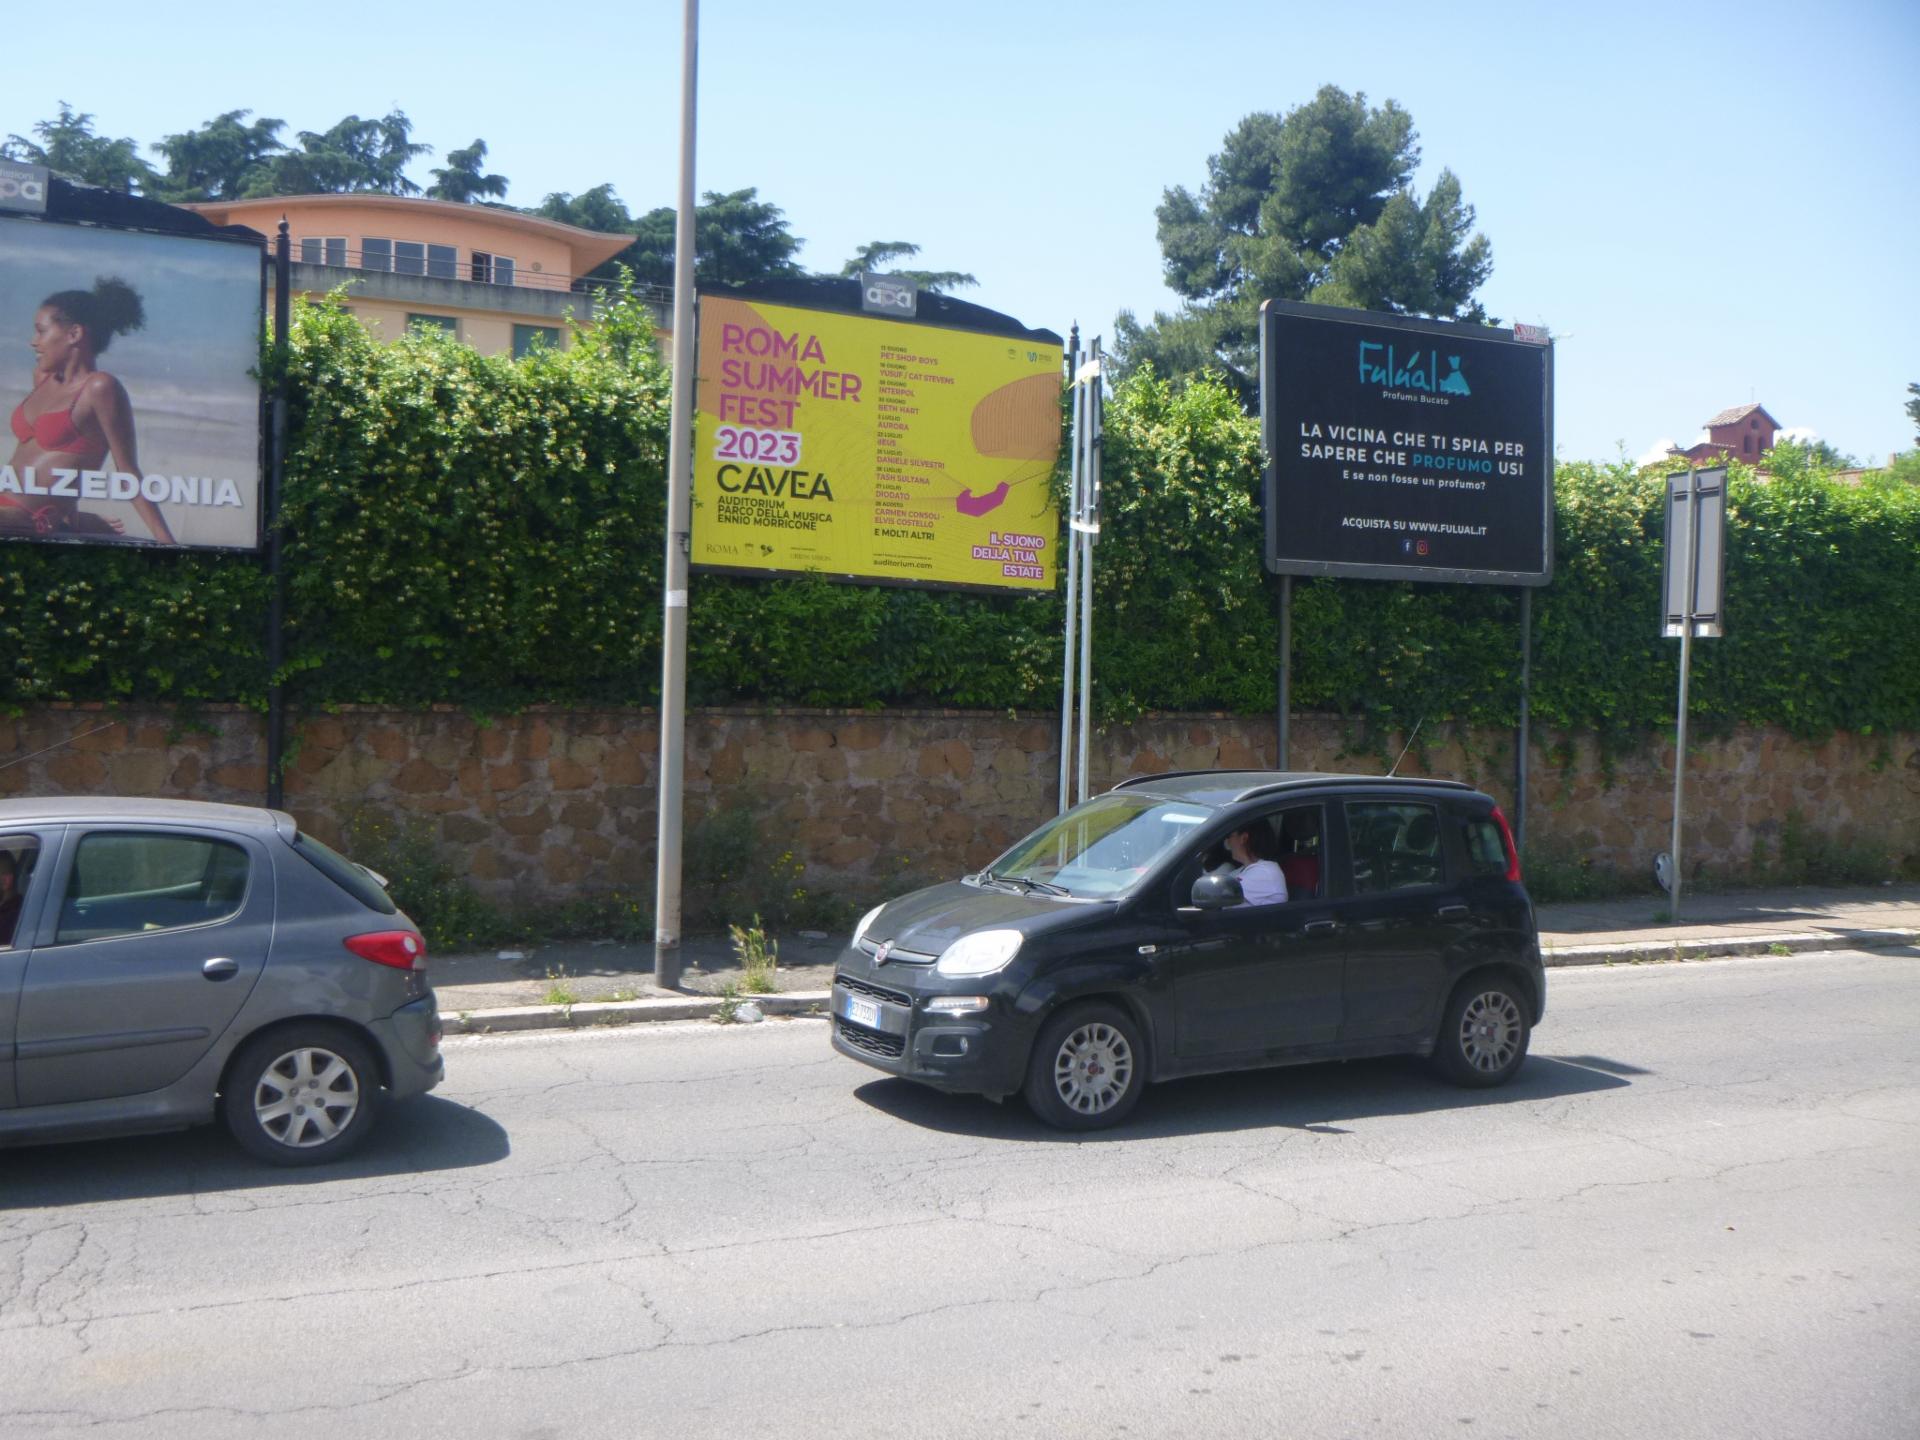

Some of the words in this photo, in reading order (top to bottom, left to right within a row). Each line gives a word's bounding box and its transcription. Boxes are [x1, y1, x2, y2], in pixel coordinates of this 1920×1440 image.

[722, 323, 826, 364] ROMA
[880, 352, 894, 360] PET
[896, 354, 917, 363] SHOP
[919, 356, 938, 366] BOYS
[721, 359, 862, 402] SUMMER
[909, 372, 922, 381] CAT
[924, 374, 955, 385] STEVENS
[1420, 394, 1449, 405] Bucato
[719, 393, 801, 429] FEST
[878, 422, 909, 431] AURORA
[717, 428, 799, 463] 2023
[1301, 422, 1322, 438] LA
[1328, 425, 1387, 444] VICINA
[1393, 431, 1426, 448] CHE
[1431, 435, 1446, 450] TI
[1452, 437, 1488, 454] SPIA
[1494, 441, 1524, 457] PER
[877, 456, 907, 466] DANIELE
[910, 458, 945, 469] SILVESTRI
[1301, 443, 1367, 462] SAPERE
[1373, 450, 1406, 466] CHE
[1413, 453, 1492, 473] PROFUMO
[1498, 461, 1523, 476] USI
[716, 464, 834, 501] CAVEA
[876, 473, 895, 481] TASH
[1343, 470, 1349, 479] E
[1353, 472, 1364, 480] se
[1368, 473, 1388, 482] non
[1391, 473, 1419, 485] fosse
[1422, 477, 1435, 486] un
[1438, 479, 1486, 490] profumo?
[0, 464, 242, 507] ALZEDONIA
[876, 490, 911, 500] DIODATO
[718, 496, 785, 509] AUDITORIUM
[718, 505, 754, 517] PARCO
[757, 508, 790, 520] DELLA
[793, 511, 833, 523] MUSICA
[875, 508, 906, 517] CARMEN
[908, 511, 940, 521] CONSOLI
[717, 514, 751, 525] ENNIO
[753, 517, 817, 531] MORRICONE
[874, 517, 895, 525] ELVIS
[897, 519, 934, 529] COSTELLO
[1342, 517, 1391, 530] ACQUISTA
[1393, 520, 1406, 530] SU
[1408, 522, 1488, 535] WWW.FULUAL.IT
[874, 528, 880, 537] E
[882, 529, 909, 539] MOLTI
[910, 531, 935, 541] ALTRI
[990, 533, 1001, 545] IL
[1003, 534, 1045, 548] SUONO
[706, 543, 739, 555] ROMA
[973, 547, 1010, 560] DELLA
[1013, 550, 1037, 563] TUA
[873, 559, 933, 570] auditorium.com
[1003, 564, 1043, 578] ESTATE
